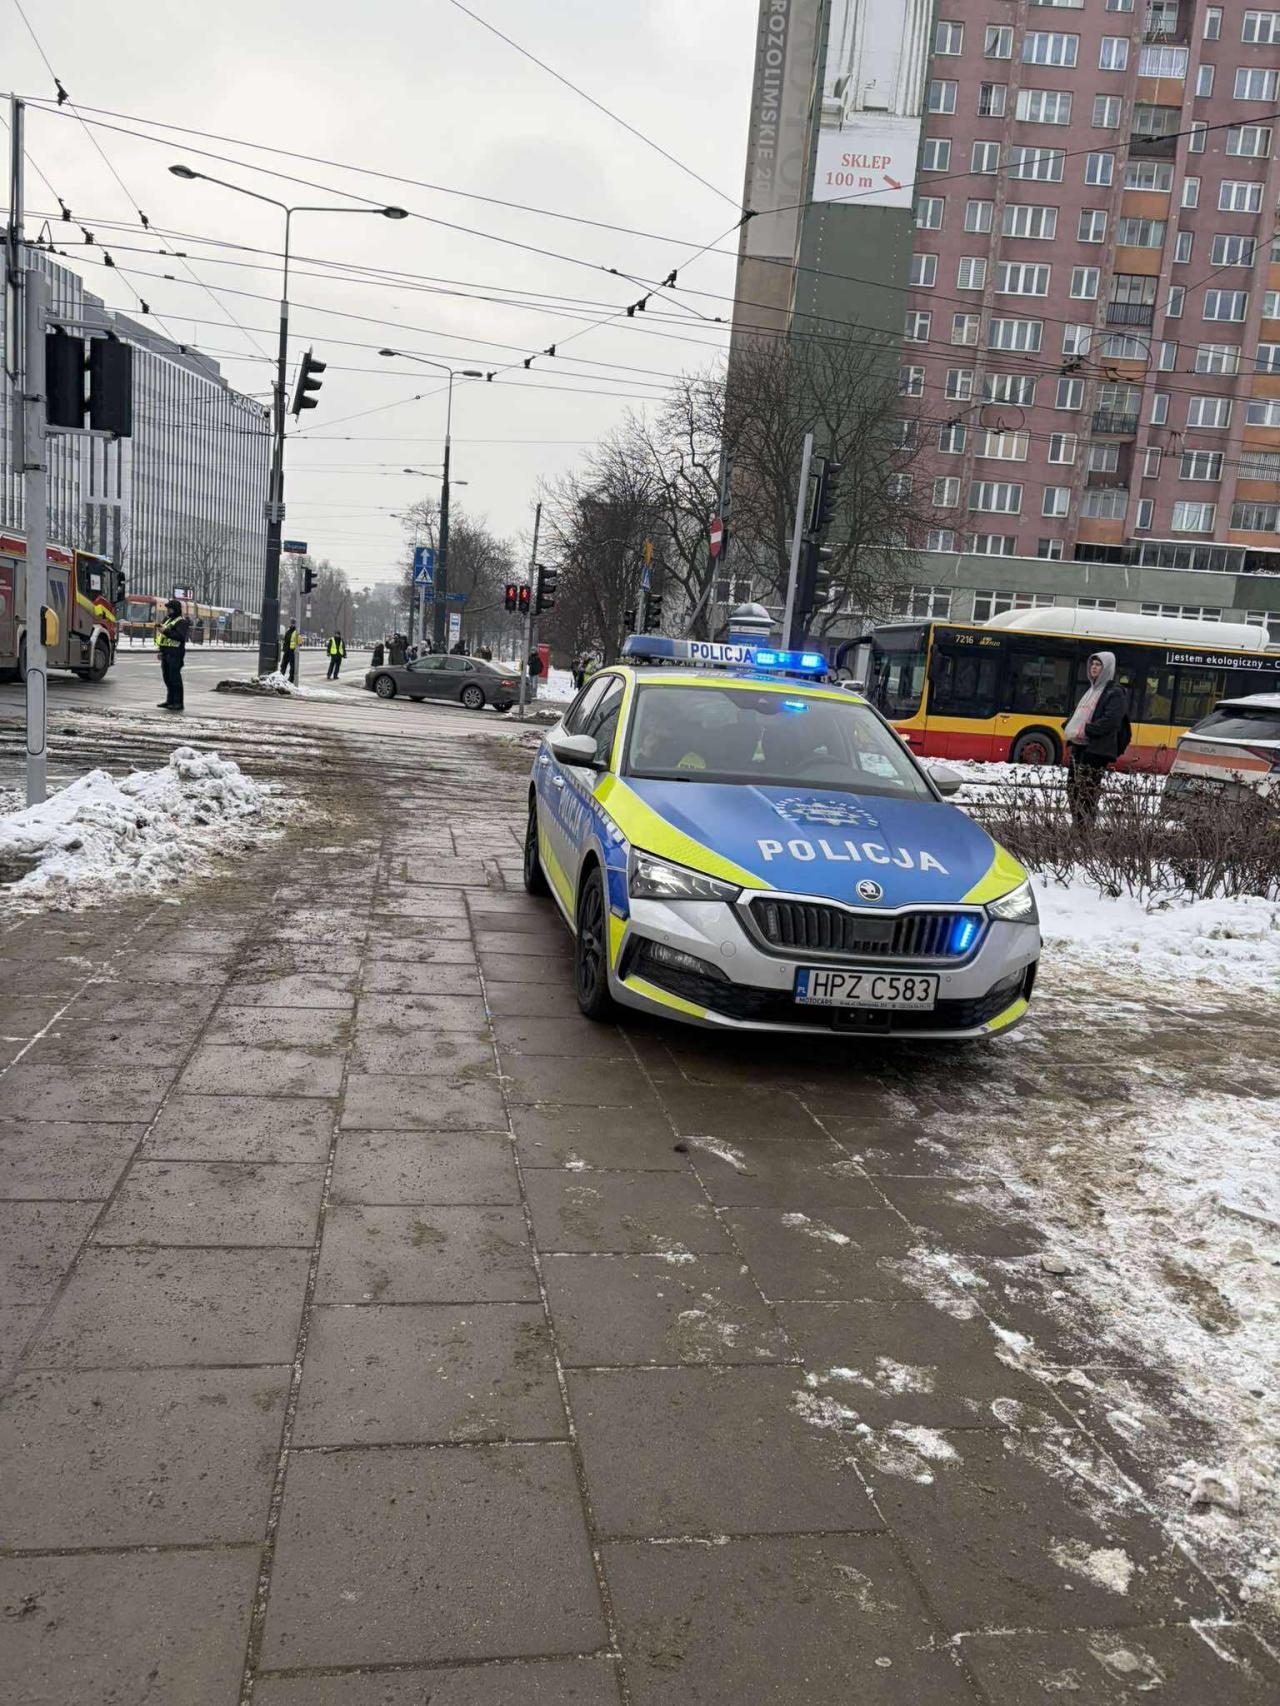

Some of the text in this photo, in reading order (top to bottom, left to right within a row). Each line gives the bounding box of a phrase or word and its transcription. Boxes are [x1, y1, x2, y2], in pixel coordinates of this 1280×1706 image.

[841, 152, 892, 170] SKLEP
[825, 171, 873, 188] 100 m
[955, 634, 974, 645] 7216
[690, 642, 754, 664] POLICJA
[1171, 651, 1203, 663] jestem
[1206, 655, 1263, 670] ekologiczny
[757, 839, 950, 875] POLICJA
[813, 972, 931, 1002] HPZ C583
